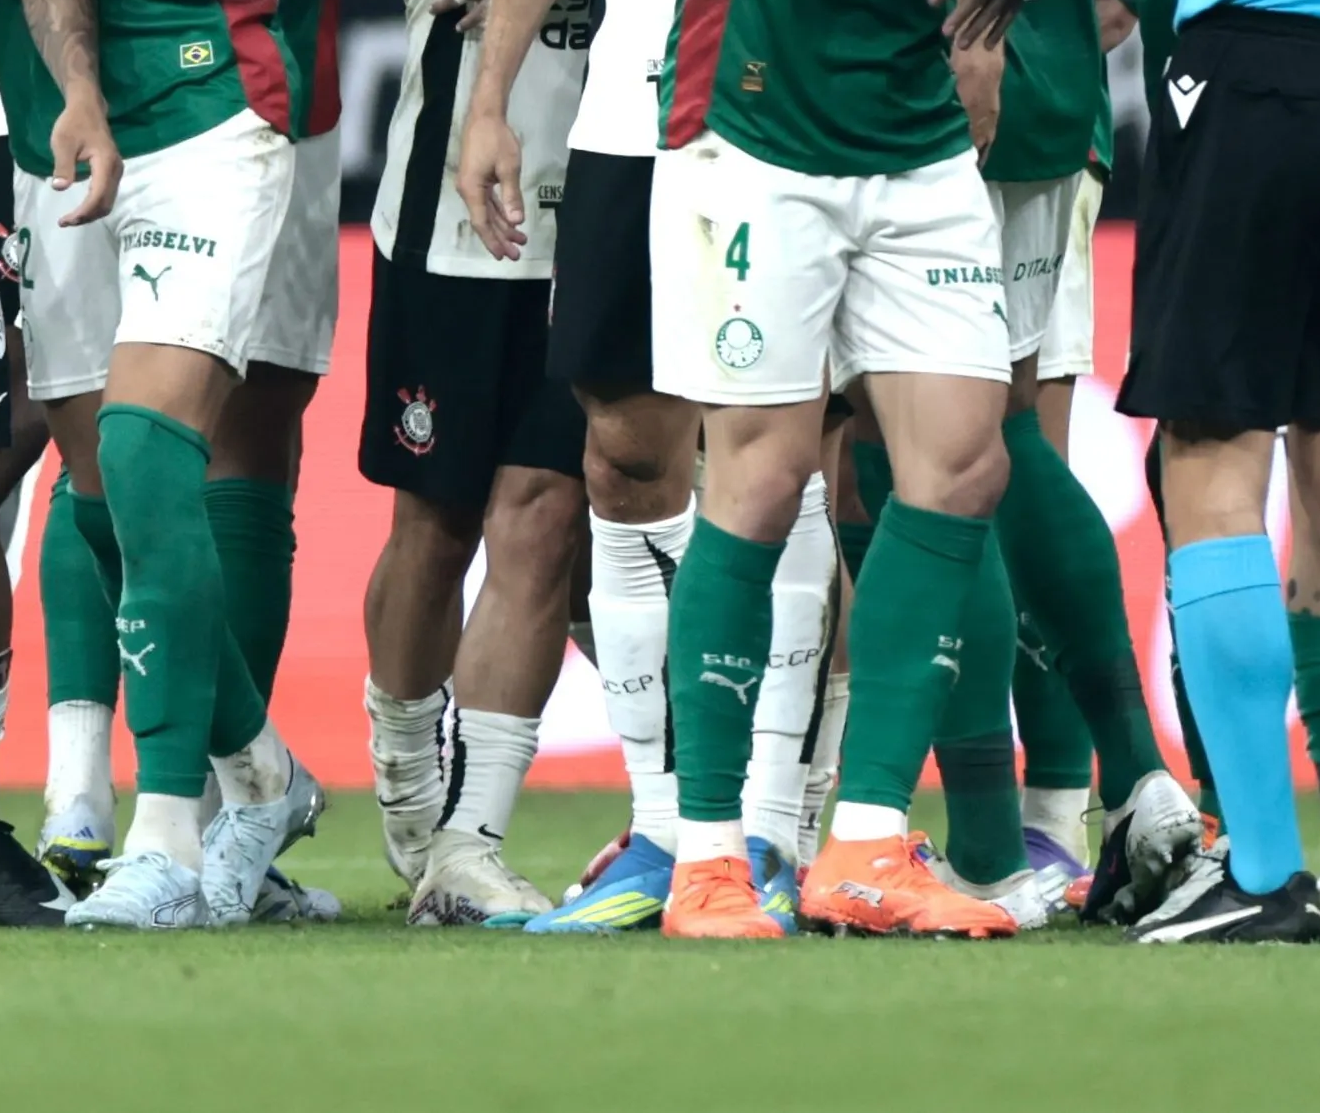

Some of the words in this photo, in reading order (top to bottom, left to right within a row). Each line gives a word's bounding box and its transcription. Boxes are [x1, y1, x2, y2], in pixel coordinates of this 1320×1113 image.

[538, 185, 563, 200] CENS
[724, 221, 751, 282] 4
[766, 648, 821, 670] CCP
[601, 673, 654, 696] CCP
